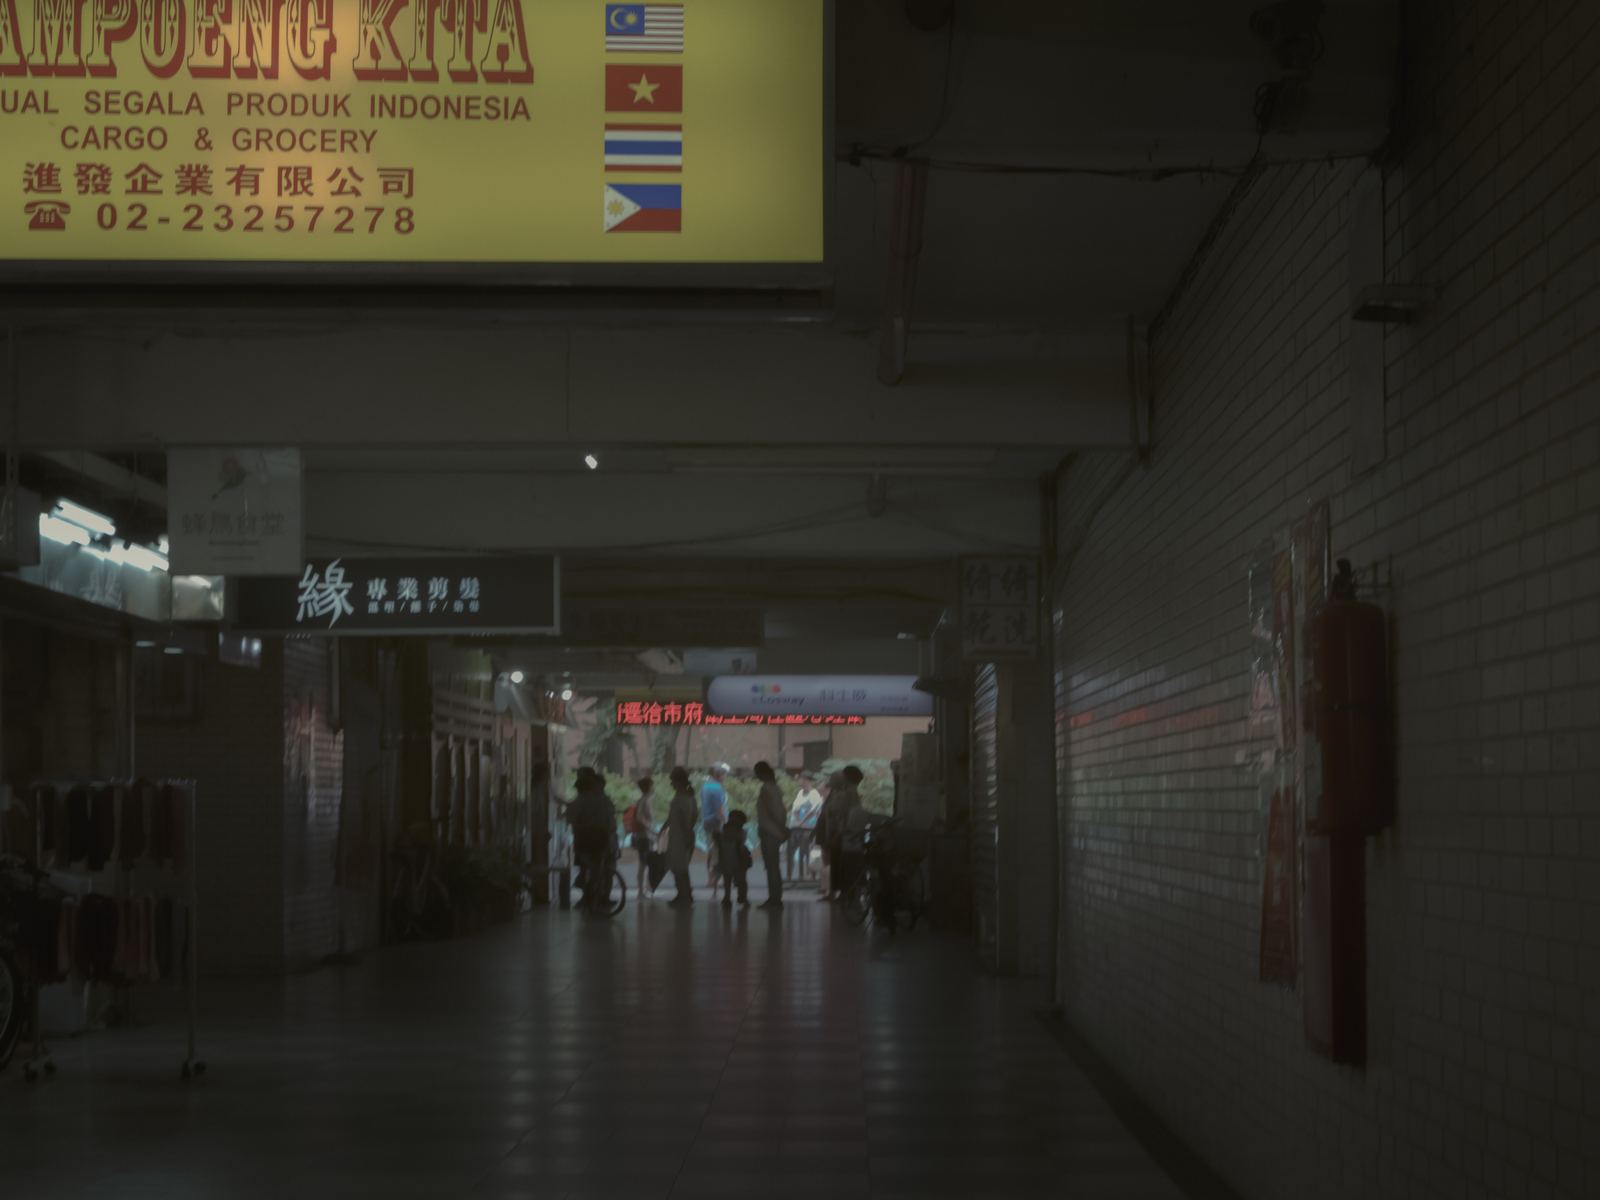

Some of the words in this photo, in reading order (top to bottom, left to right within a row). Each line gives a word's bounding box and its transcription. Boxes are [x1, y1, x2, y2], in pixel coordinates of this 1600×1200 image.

[352, 0, 534, 84] KITA
[0, 89, 58, 115] UAL
[84, 90, 205, 116] SEGALA
[227, 92, 351, 118] PRODUK
[370, 95, 531, 121] INDONESIA
[60, 125, 169, 151] CARGO
[194, 128, 213, 151] &
[231, 128, 378, 153] GROCERY
[23, 163, 415, 198] 進發企業有限公司
[97, 203, 416, 235] 02-23257278
[295, 558, 355, 631] 緣
